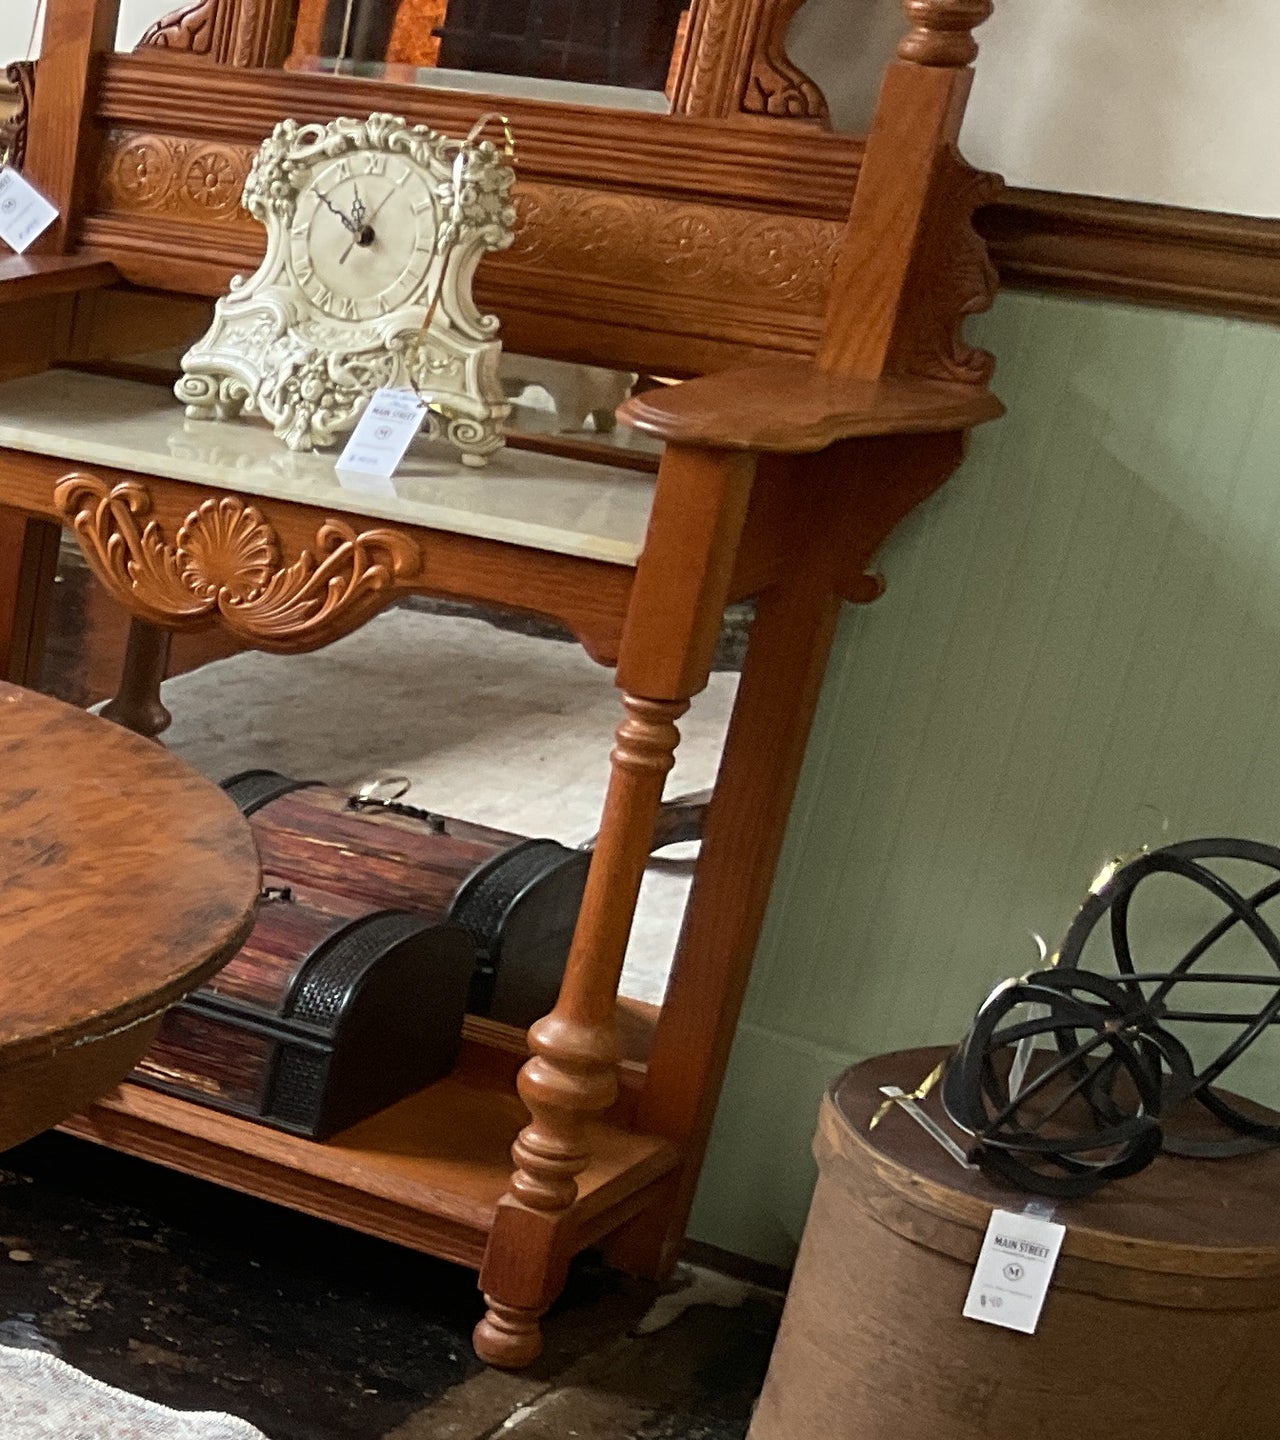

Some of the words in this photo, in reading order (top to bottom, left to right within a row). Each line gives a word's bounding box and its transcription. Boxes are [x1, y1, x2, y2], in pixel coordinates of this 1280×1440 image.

[372, 407, 391, 417] MAIN
[994, 1236, 1017, 1250] MAIN
[1019, 1244, 1050, 1259] STREET
